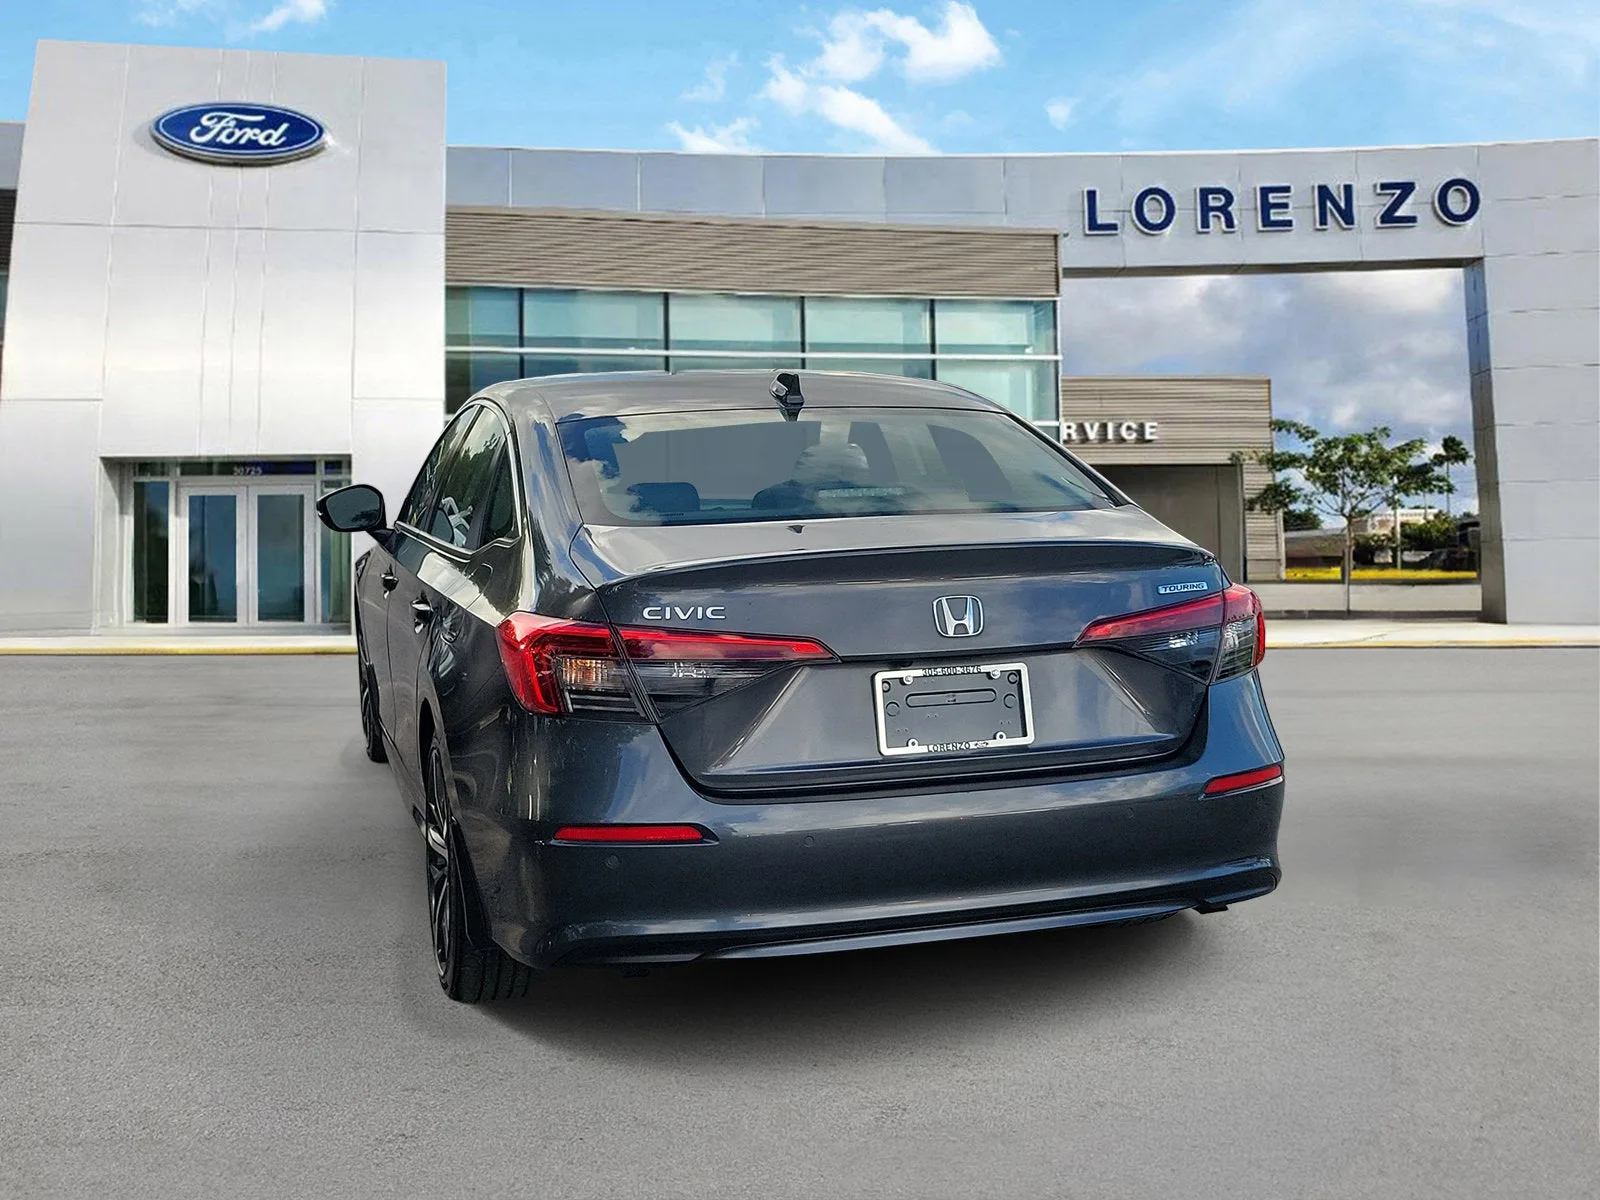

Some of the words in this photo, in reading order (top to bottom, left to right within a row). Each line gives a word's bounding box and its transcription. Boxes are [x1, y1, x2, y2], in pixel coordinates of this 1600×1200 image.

[189, 111, 290, 146] Ford
[1083, 178, 1481, 236] LORENZO
[1161, 582, 1205, 593] TOURING
[642, 606, 726, 620] CIVIC
[927, 742, 971, 753] LORENZO
